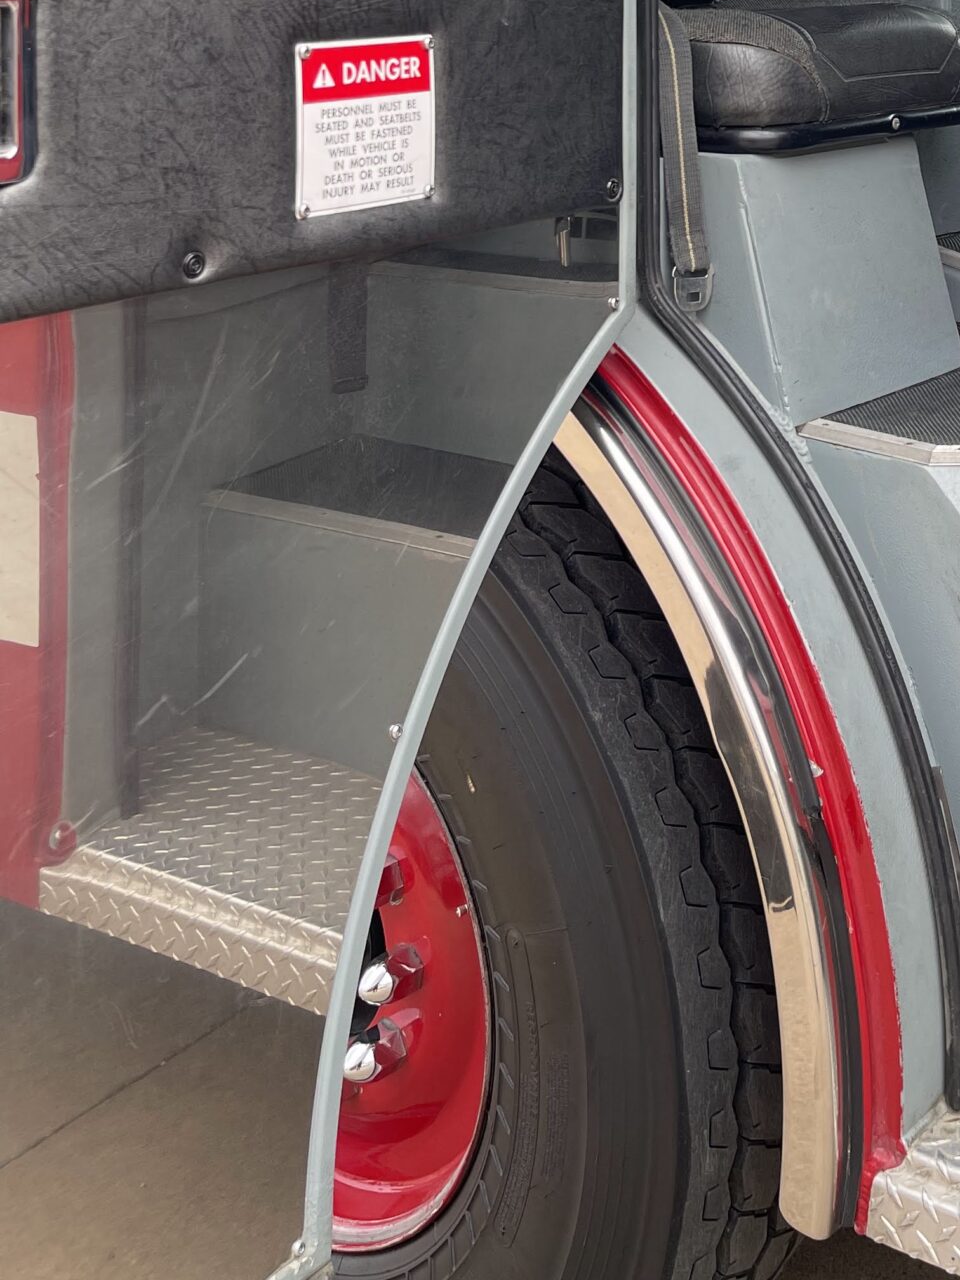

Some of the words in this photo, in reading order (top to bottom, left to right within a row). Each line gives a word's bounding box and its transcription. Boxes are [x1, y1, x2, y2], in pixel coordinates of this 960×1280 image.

[342, 56, 421, 85] DANGER
[321, 104, 373, 119] PERSONNEL
[379, 101, 401, 112] MUST
[407, 100, 416, 109] BE
[315, 121, 349, 133] SEATED
[355, 117, 374, 128] AND
[380, 111, 421, 126] SEATBELTS
[325, 133, 350, 145] MUST
[355, 131, 366, 141] BE
[371, 125, 413, 139] FASTENED
[329, 145, 357, 158] WHILE
[362, 140, 396, 153] VEHICLE
[401, 138, 409, 148] IS
[334, 161, 344, 171] IN
[350, 155, 387, 169] MOTION
[392, 152, 404, 162] OR
[324, 173, 354, 186] DEATH
[360, 170, 372, 180] OR
[378, 163, 413, 178] SERIOUS
[321, 185, 355, 199] INJURY
[361, 181, 381, 193] MAY
[386, 175, 414, 188] RESULT
